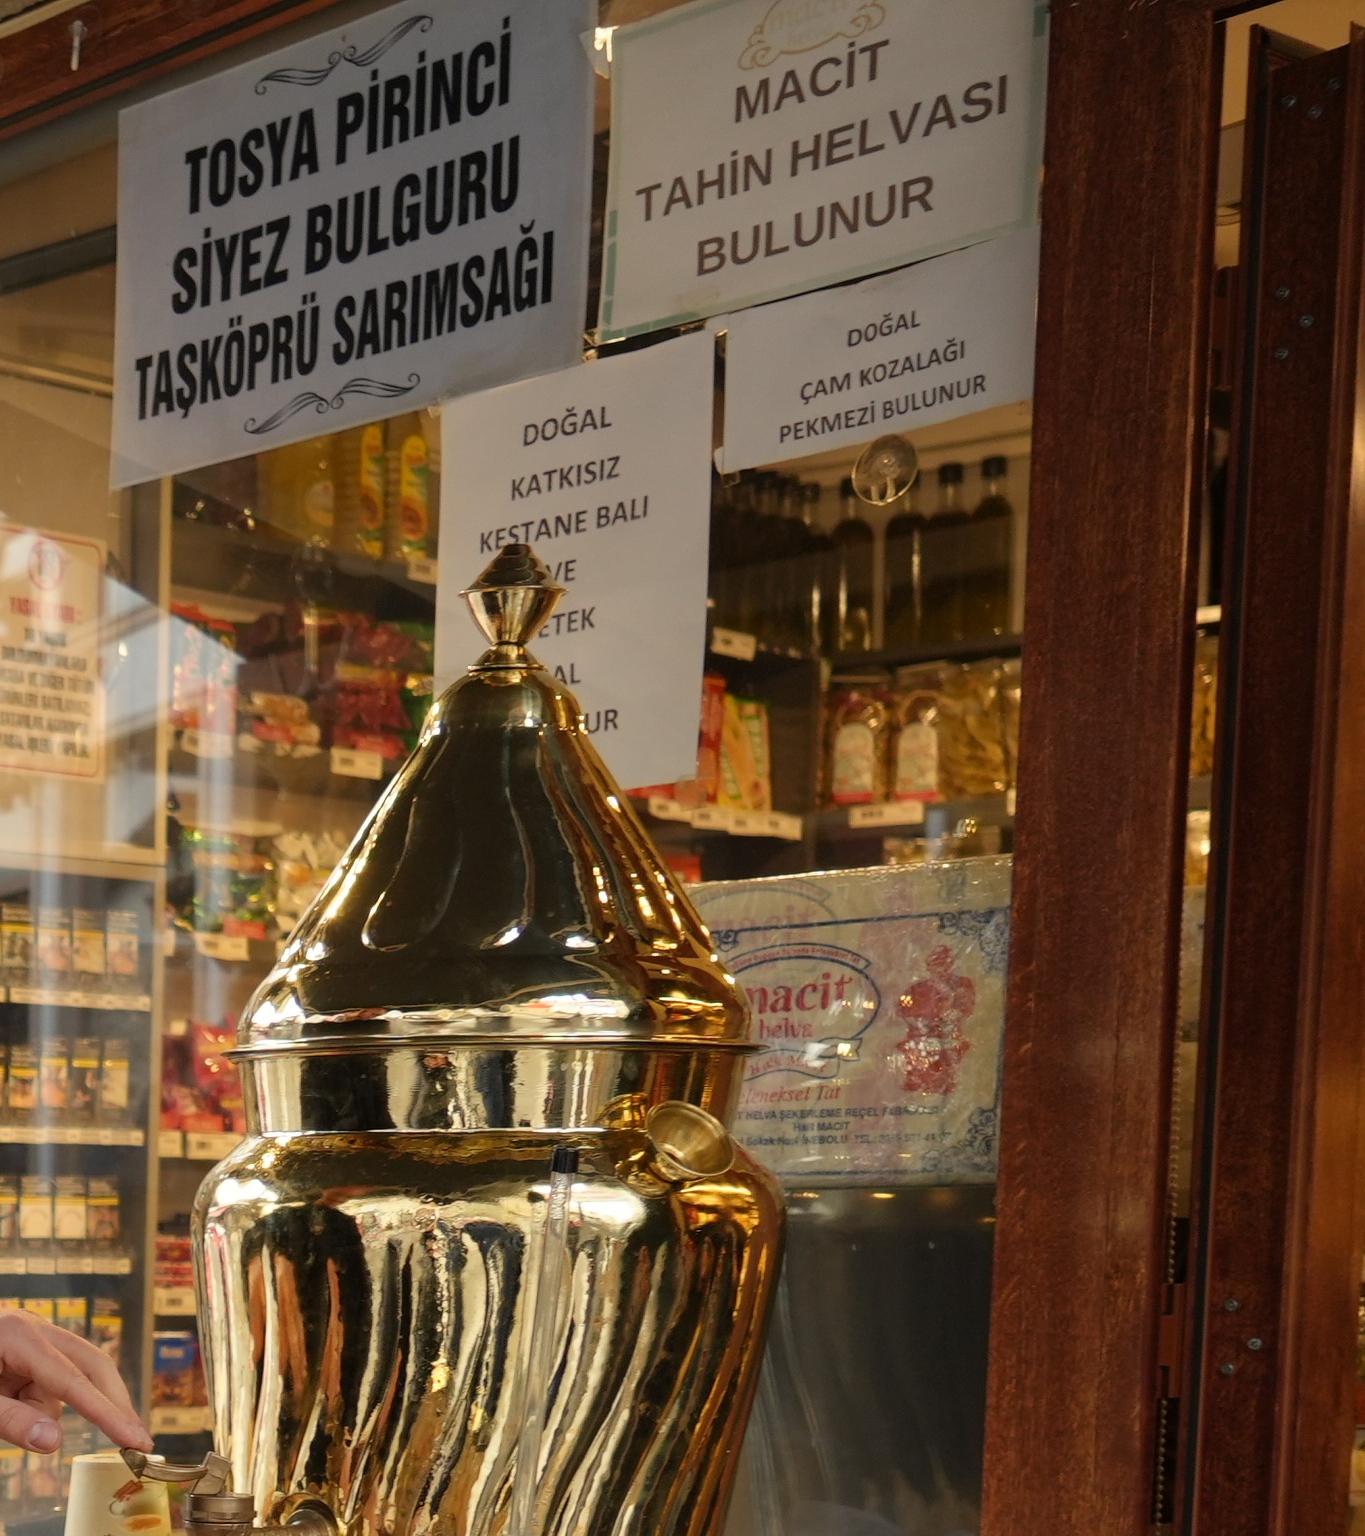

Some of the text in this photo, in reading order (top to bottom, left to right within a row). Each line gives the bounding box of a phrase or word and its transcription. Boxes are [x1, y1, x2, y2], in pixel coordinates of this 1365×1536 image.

[734, 39, 891, 124] MACİT
[184, 16, 512, 215] TOSYA PİRİNCİ
[635, 74, 1009, 223] TAHİN HELVASI
[171, 135, 521, 315] SİYEZ BULGURU
[696, 175, 934, 277] BULUNUR
[135, 219, 555, 421] TAŞKÖPRÜ SARIMSAĞI
[846, 310, 922, 348] DOĞAL
[799, 338, 966, 405] ÇAM KOZALAĞI
[522, 406, 613, 448] DOĞAL
[778, 374, 987, 444] PEKMEZİ BULUNUR
[510, 455, 622, 501] KATKISIZ
[479, 495, 650, 555] KESTANE BALI
[537, 606, 597, 639] ETEK
[553, 662, 582, 686] AL
[758, 1017, 815, 1041] helva
